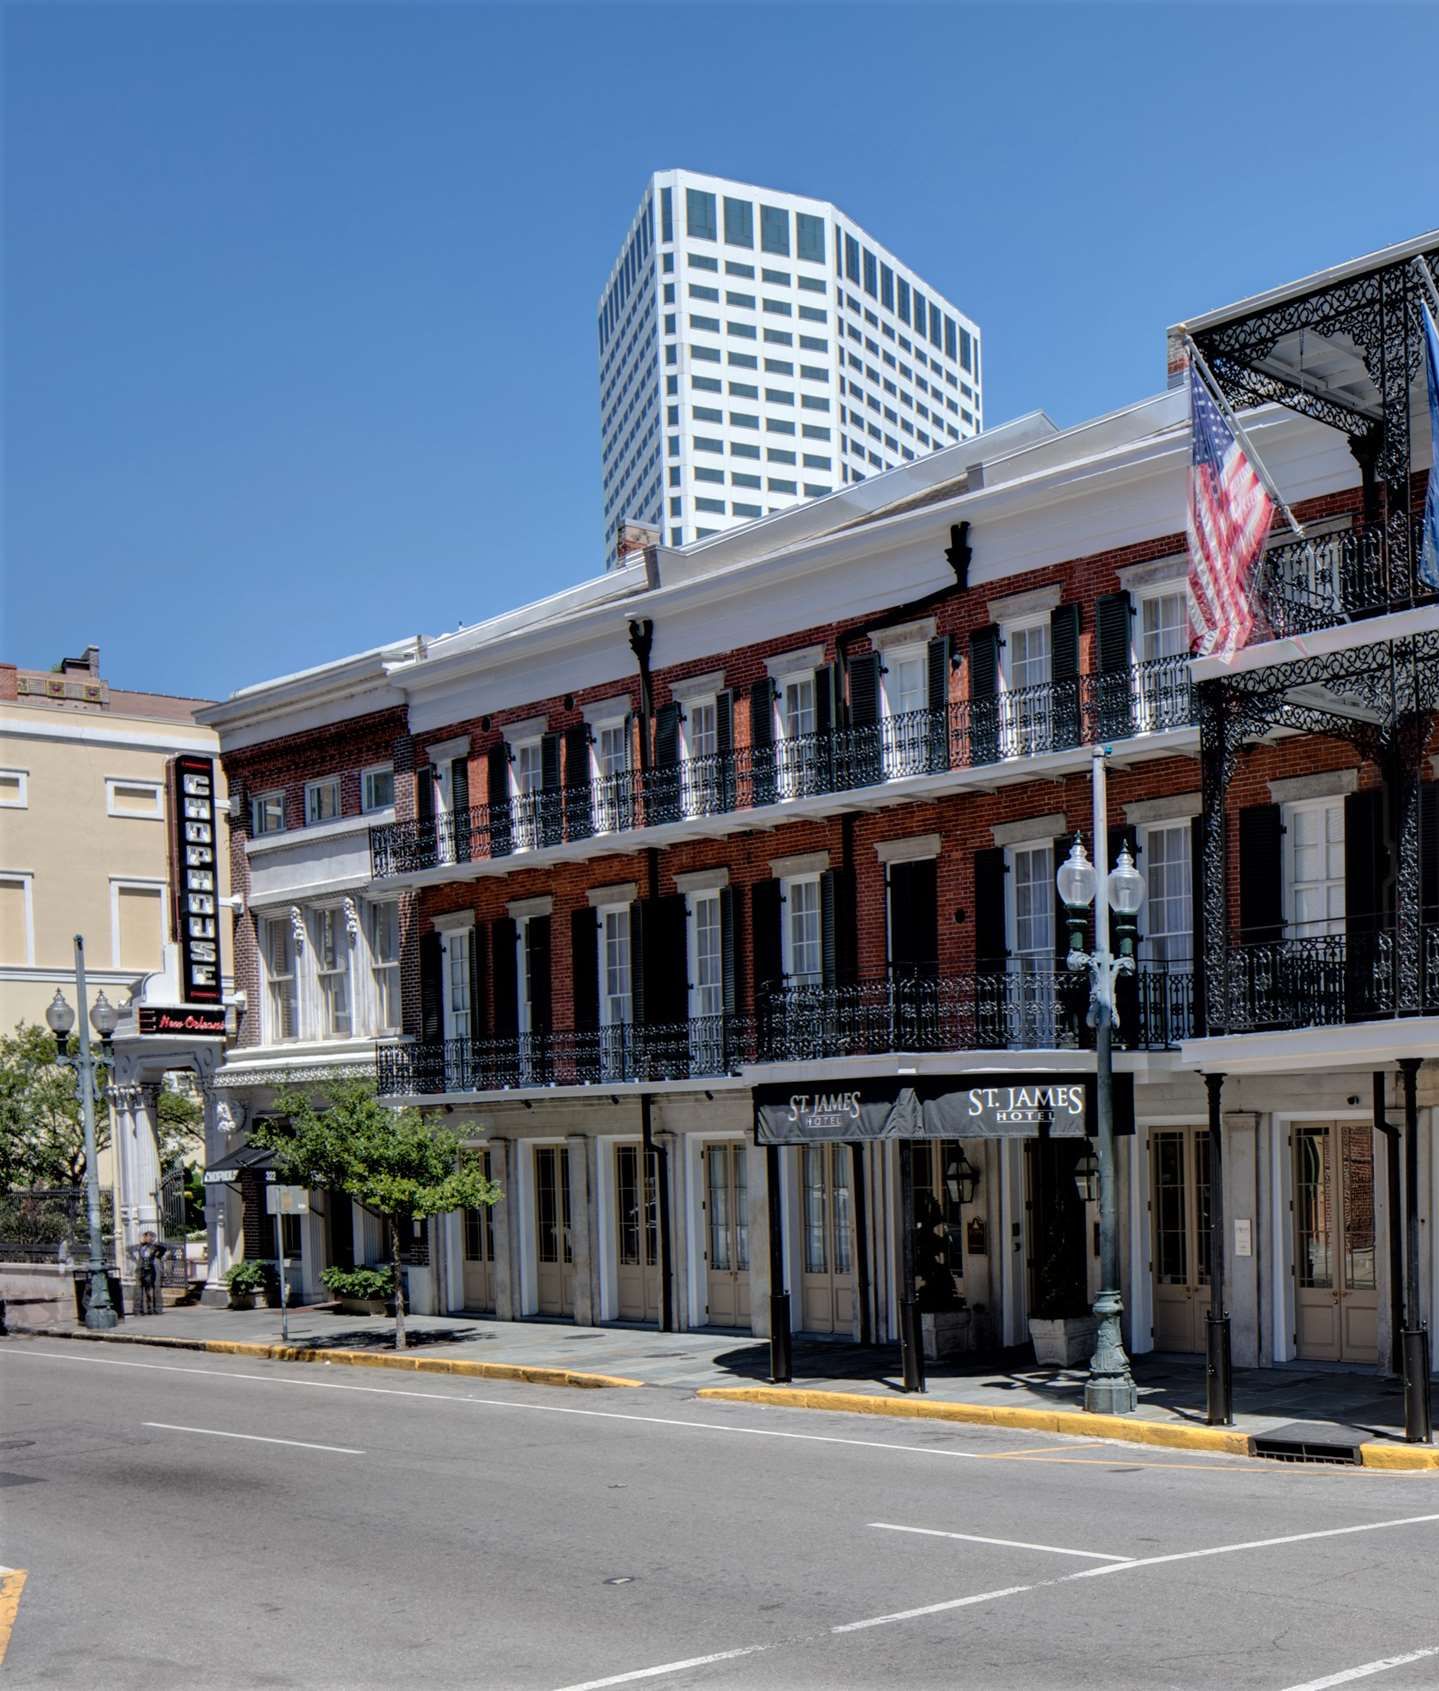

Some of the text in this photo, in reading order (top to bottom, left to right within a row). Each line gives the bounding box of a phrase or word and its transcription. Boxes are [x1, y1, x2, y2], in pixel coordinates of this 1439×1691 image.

[183, 773, 216, 986] CHOPHOUSE
[788, 1091, 861, 1121] ST. JAMES
[968, 1087, 1083, 1116] ST. JAMES
[996, 1111, 1056, 1121] HOTEL
[808, 1117, 841, 1127] HOTEL
